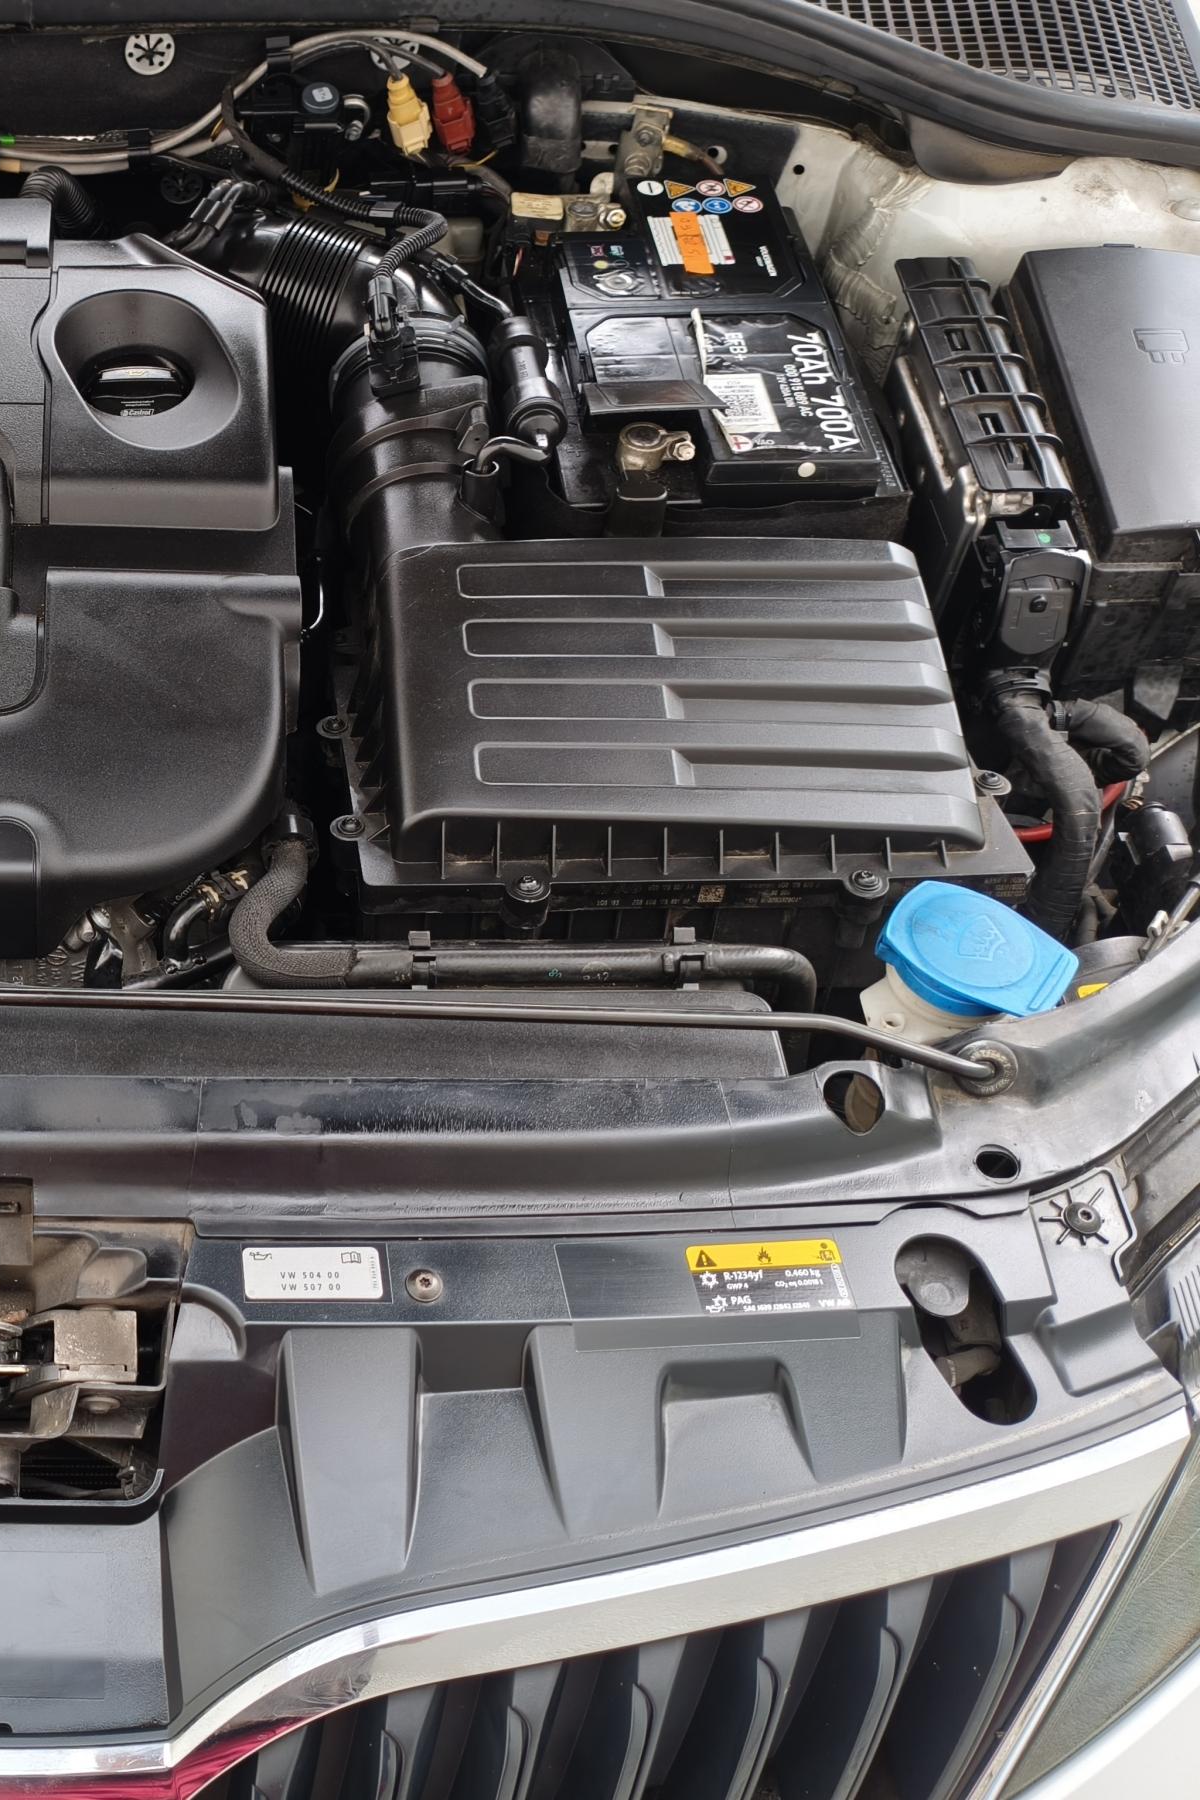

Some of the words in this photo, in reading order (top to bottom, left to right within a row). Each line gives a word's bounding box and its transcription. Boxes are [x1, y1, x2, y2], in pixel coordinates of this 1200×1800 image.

[724, 332, 748, 361] EFB+
[784, 363, 799, 377] 000
[788, 377, 803, 391] 915
[787, 332, 831, 384] 70Ah
[810, 395, 860, 451] 700A
[792, 391, 808, 405] 089
[797, 405, 813, 417] AC
[280, 1271, 296, 1279] VW
[302, 1271, 322, 1279] 504
[327, 1271, 340, 1279] 00
[723, 1270, 763, 1281] R-1234yf
[809, 1268, 821, 1278] kg
[281, 1283, 297, 1291] VW
[303, 1283, 323, 1291] 507
[329, 1283, 341, 1291] 00
[730, 1295, 752, 1305] PAG
[818, 1299, 835, 1308] VW
